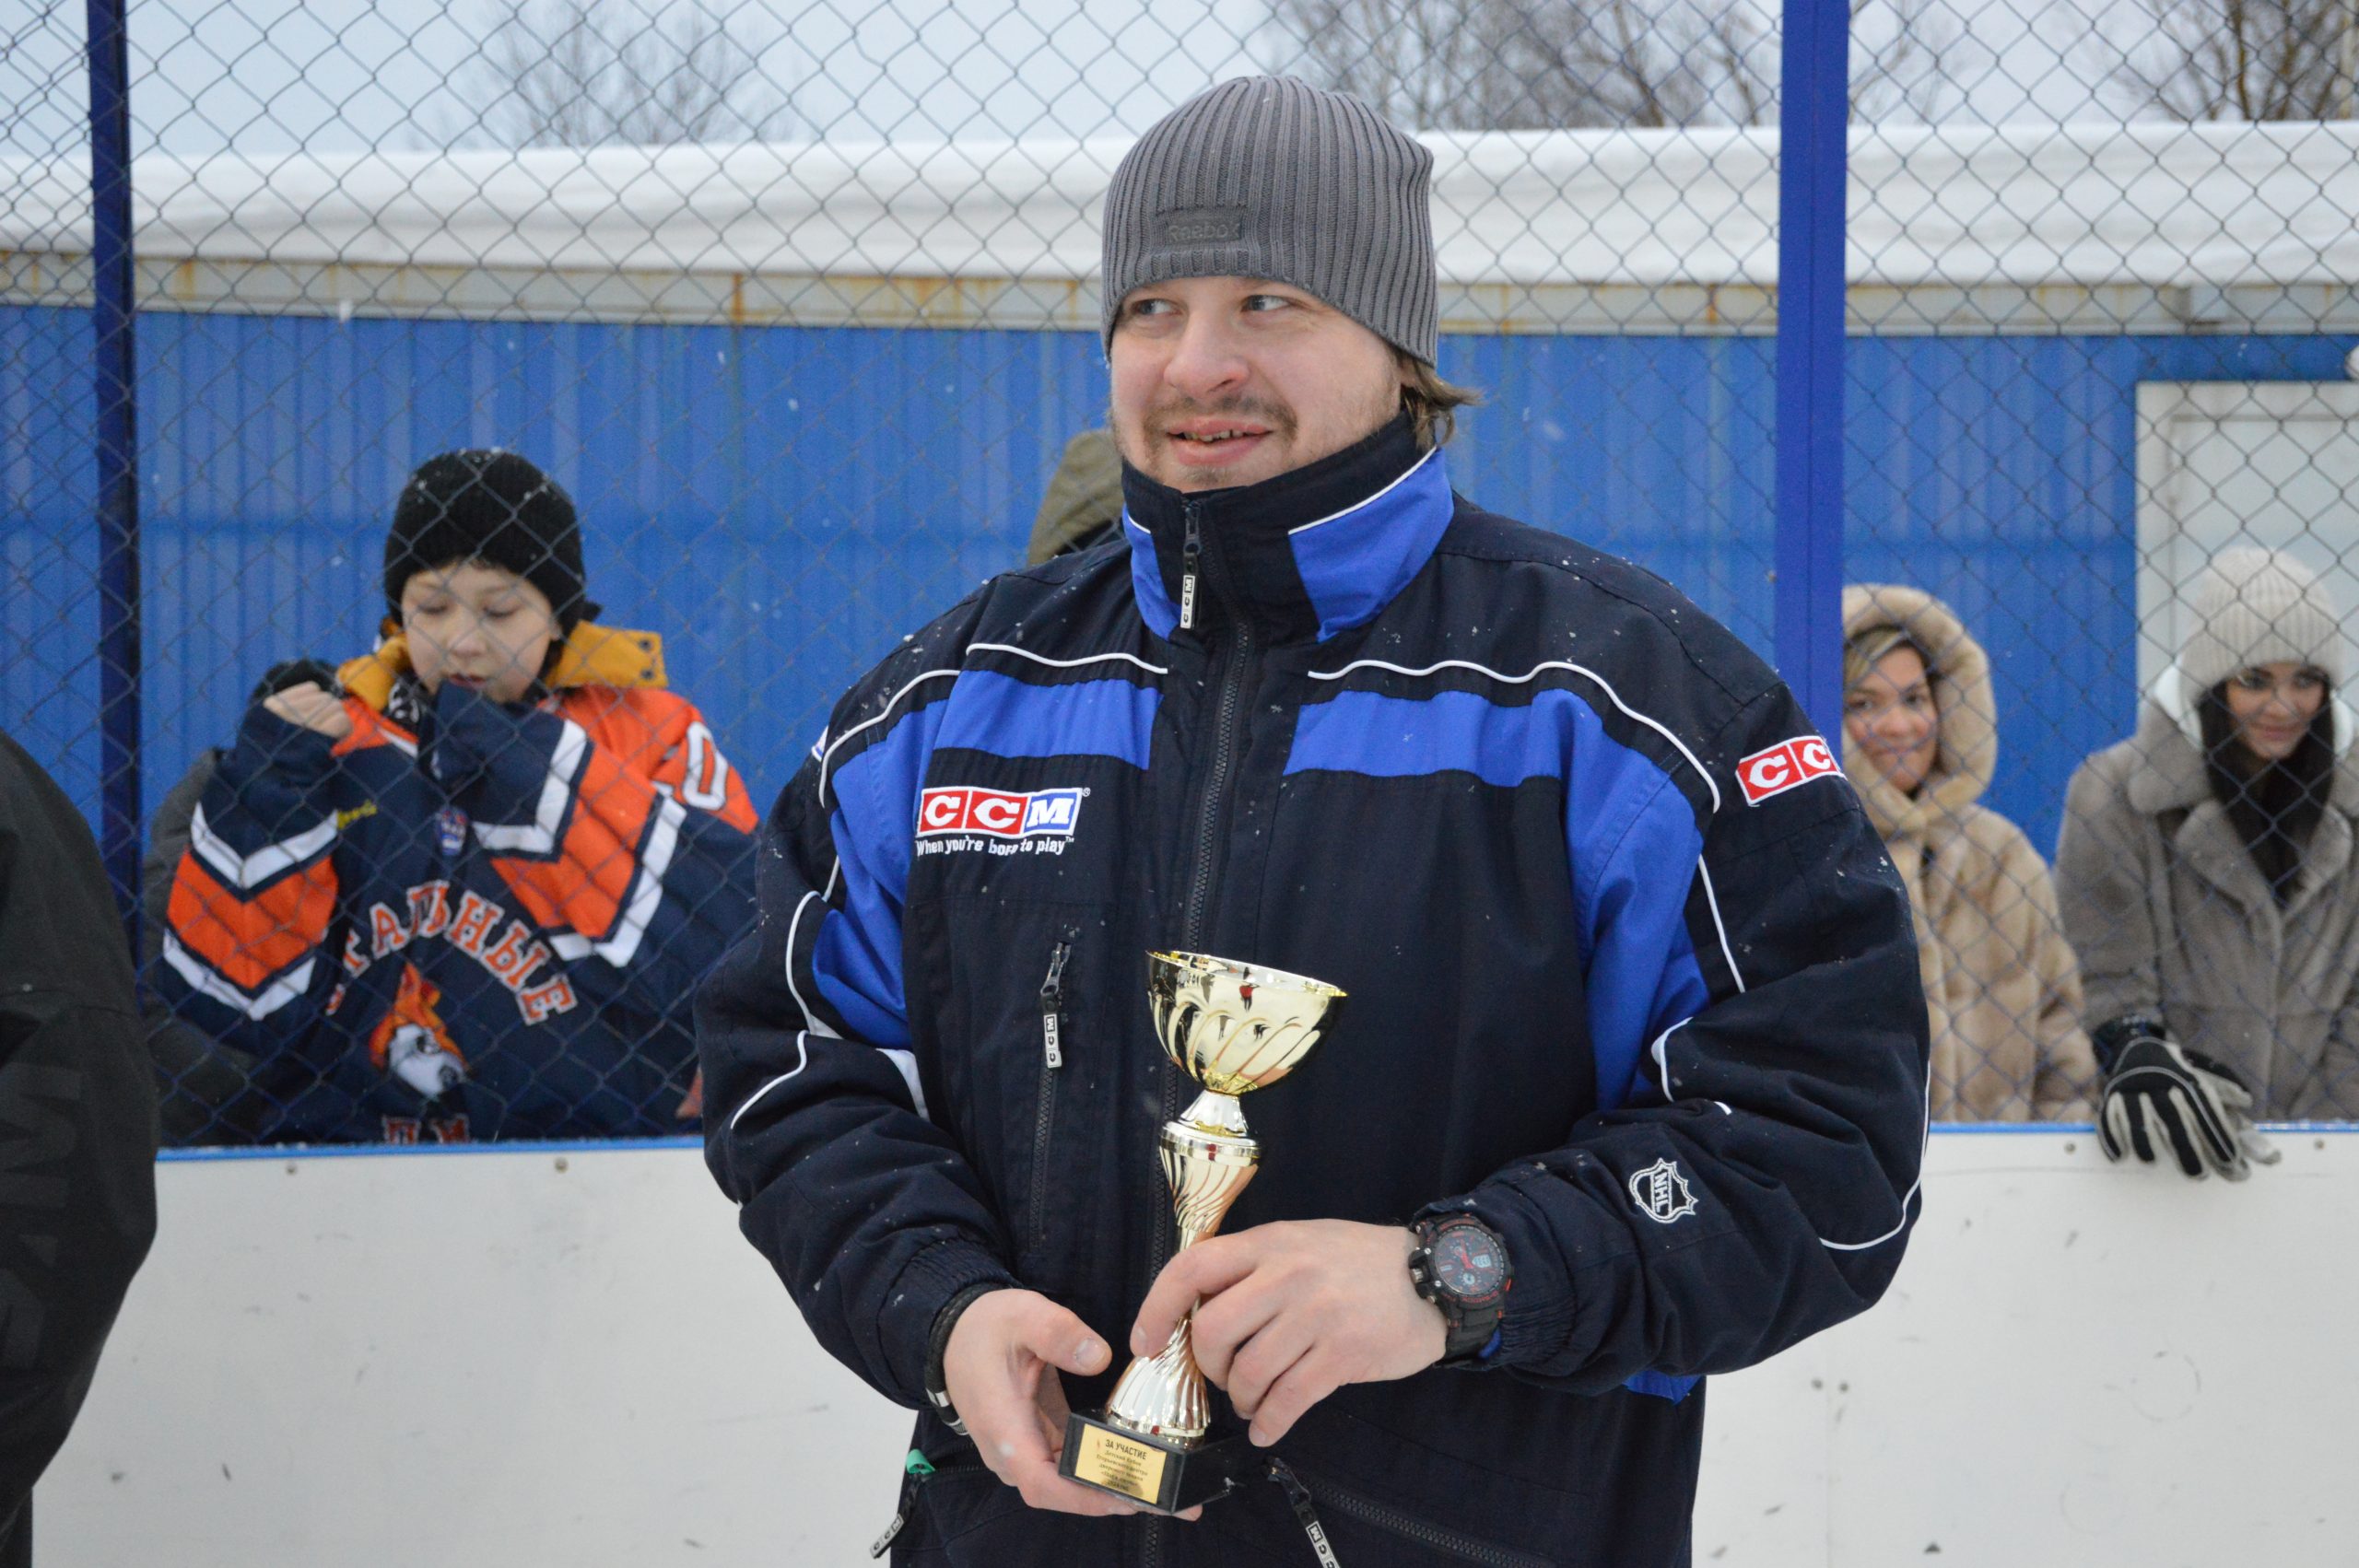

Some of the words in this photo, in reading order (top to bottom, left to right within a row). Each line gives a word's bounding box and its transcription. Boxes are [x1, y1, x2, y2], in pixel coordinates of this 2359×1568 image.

[1183, 578, 1194, 624] CCM
[923, 795, 1074, 829] CCM
[915, 839, 944, 857] When
[945, 835, 984, 855] you're
[1020, 837, 1034, 852] to
[1046, 1016, 1056, 1062] CCM
[1654, 1171, 1669, 1213] NHL
[1105, 1439, 1114, 1449] ЗА
[1116, 1442, 1147, 1460] УЧАСТИЕ
